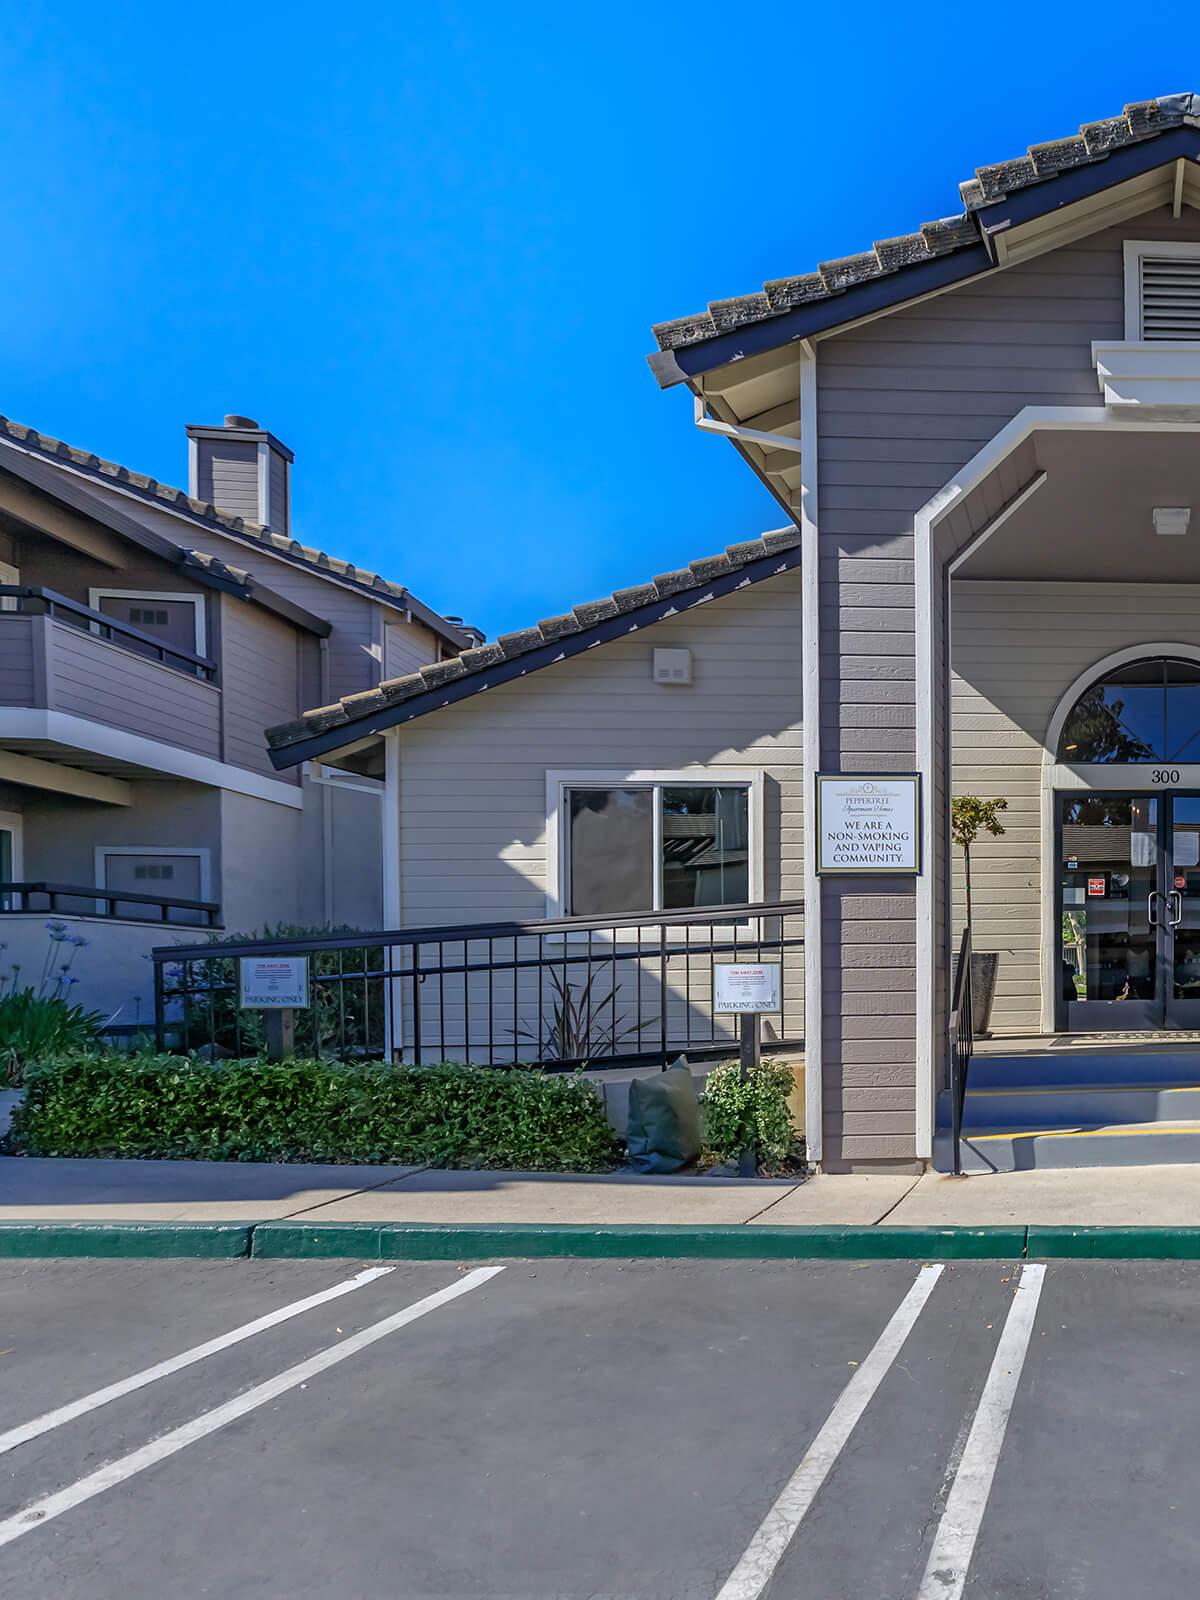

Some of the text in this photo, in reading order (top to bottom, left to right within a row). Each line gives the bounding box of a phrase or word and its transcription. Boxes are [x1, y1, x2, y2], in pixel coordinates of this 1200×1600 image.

[1151, 770, 1180, 784] 300
[844, 822, 892, 830] WE ARE A
[828, 832, 909, 840] NON-SMOKING
[834, 843, 902, 852] AND VAPING
